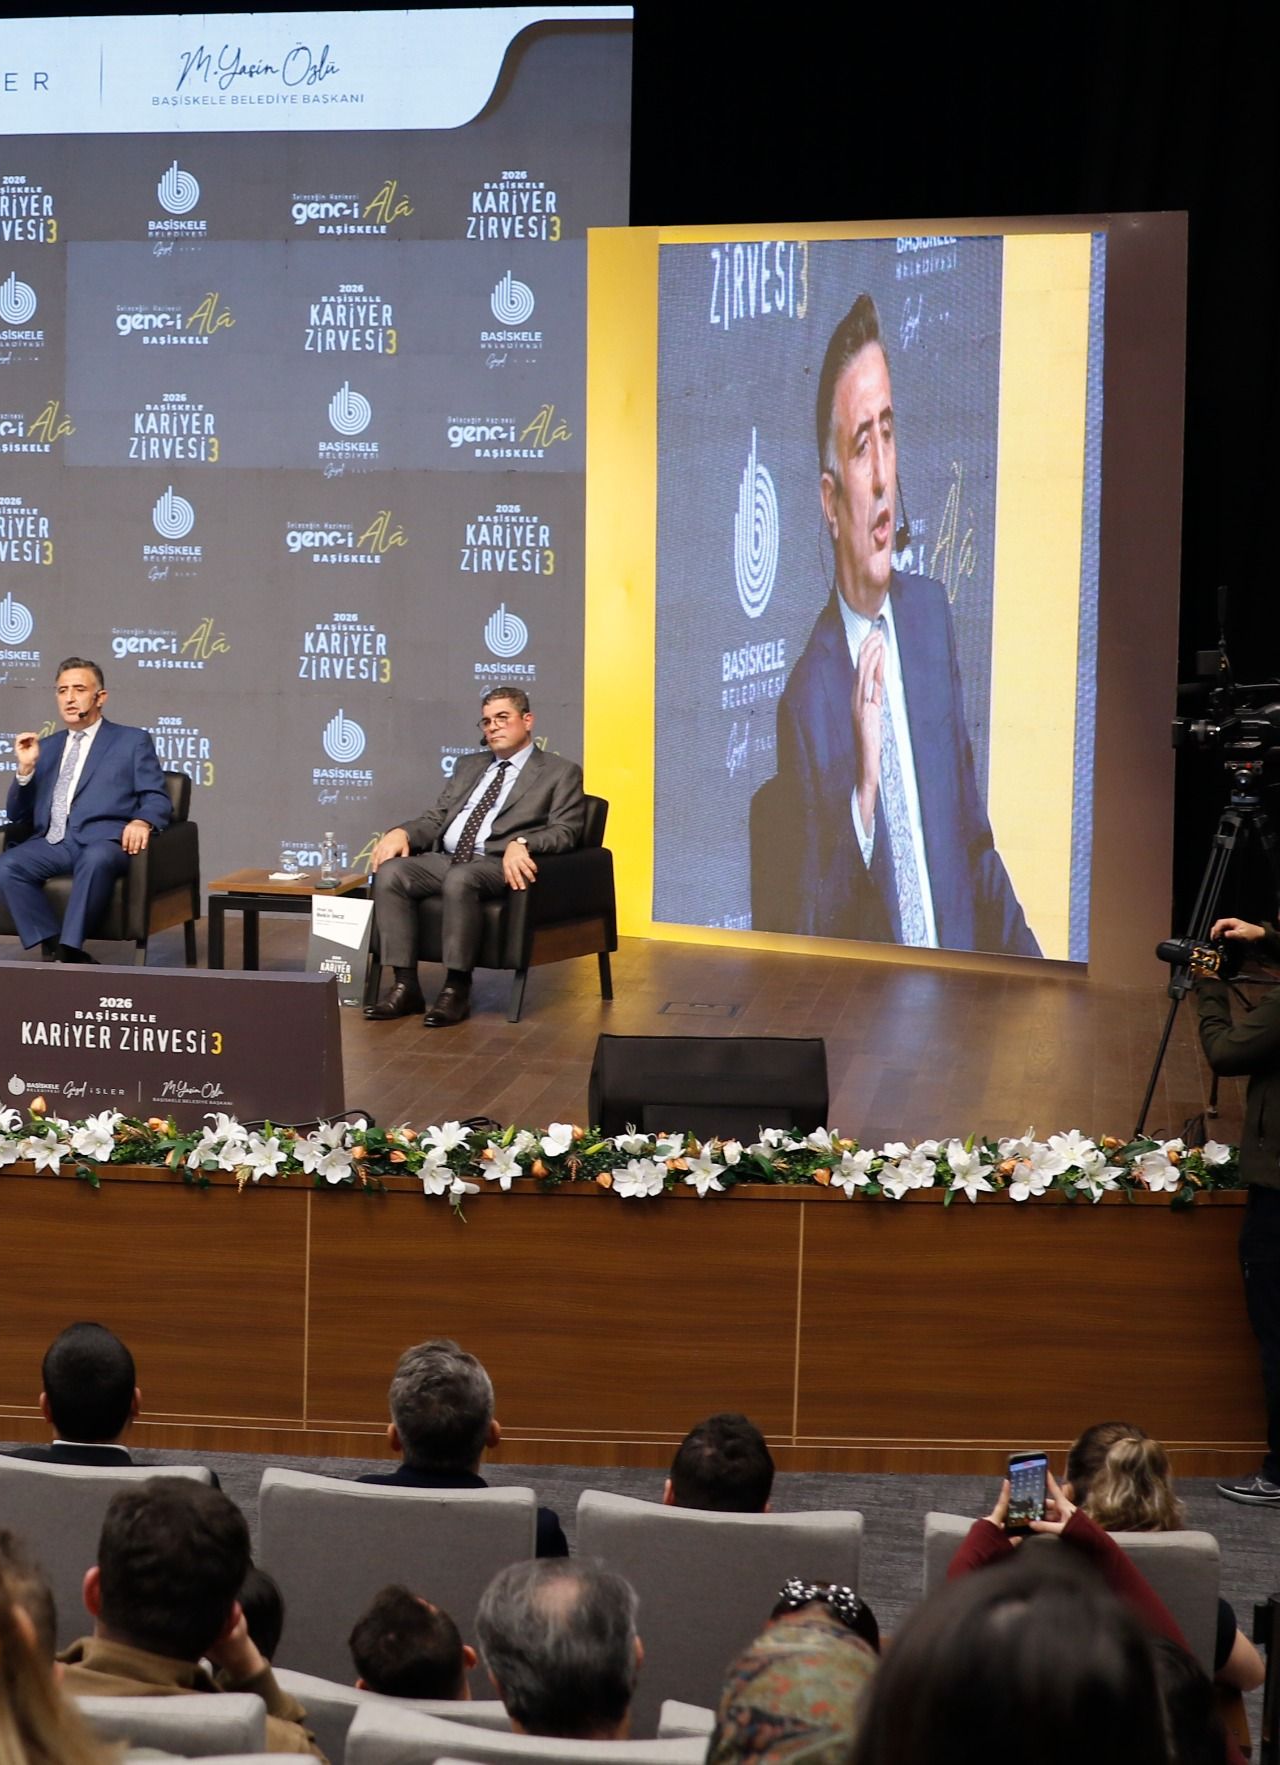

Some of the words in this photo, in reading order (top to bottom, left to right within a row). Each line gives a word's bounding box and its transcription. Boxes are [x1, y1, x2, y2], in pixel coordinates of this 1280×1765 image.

[282, 42, 340, 86] Özlü
[152, 95, 227, 106] BAŞİSKELE
[231, 94, 297, 105] BELEDİYE
[302, 93, 364, 104] BAŞKANI
[3, 176, 26, 184] 2026
[502, 171, 527, 179] 2026
[473, 189, 556, 216] KARİYER
[149, 219, 206, 230] BAŞİSKELE
[319, 224, 386, 235] BAŞİSKELE
[311, 304, 392, 329] KARİYER
[143, 335, 208, 344] BAŞİSKELE
[481, 331, 542, 341] BAŞİSKELE
[135, 413, 214, 438] KARİYER
[319, 442, 378, 451] BAŞİSKELE
[475, 449, 543, 458] BAŞİSKELE
[0, 497, 21, 505] 2026
[496, 505, 520, 513] 2026
[464, 524, 549, 551] KARİYER
[144, 544, 201, 558] BAŞİSKELE
[313, 553, 380, 563] BAŞİSKELE
[334, 613, 358, 621] 2026
[303, 632, 386, 659] KARİYER
[138, 658, 203, 669] BAŞİSKELE
[722, 638, 786, 682] BAŞİSKELE
[475, 663, 535, 676] BAŞİSKELE
[158, 717, 182, 725] 2026
[156, 736, 210, 760] RİYER
[313, 768, 372, 781] BAŞİSKELE
[100, 998, 132, 1008] 2026
[74, 1010, 157, 1023] BAŞİSKELE
[21, 1020, 111, 1050] KARİYER
